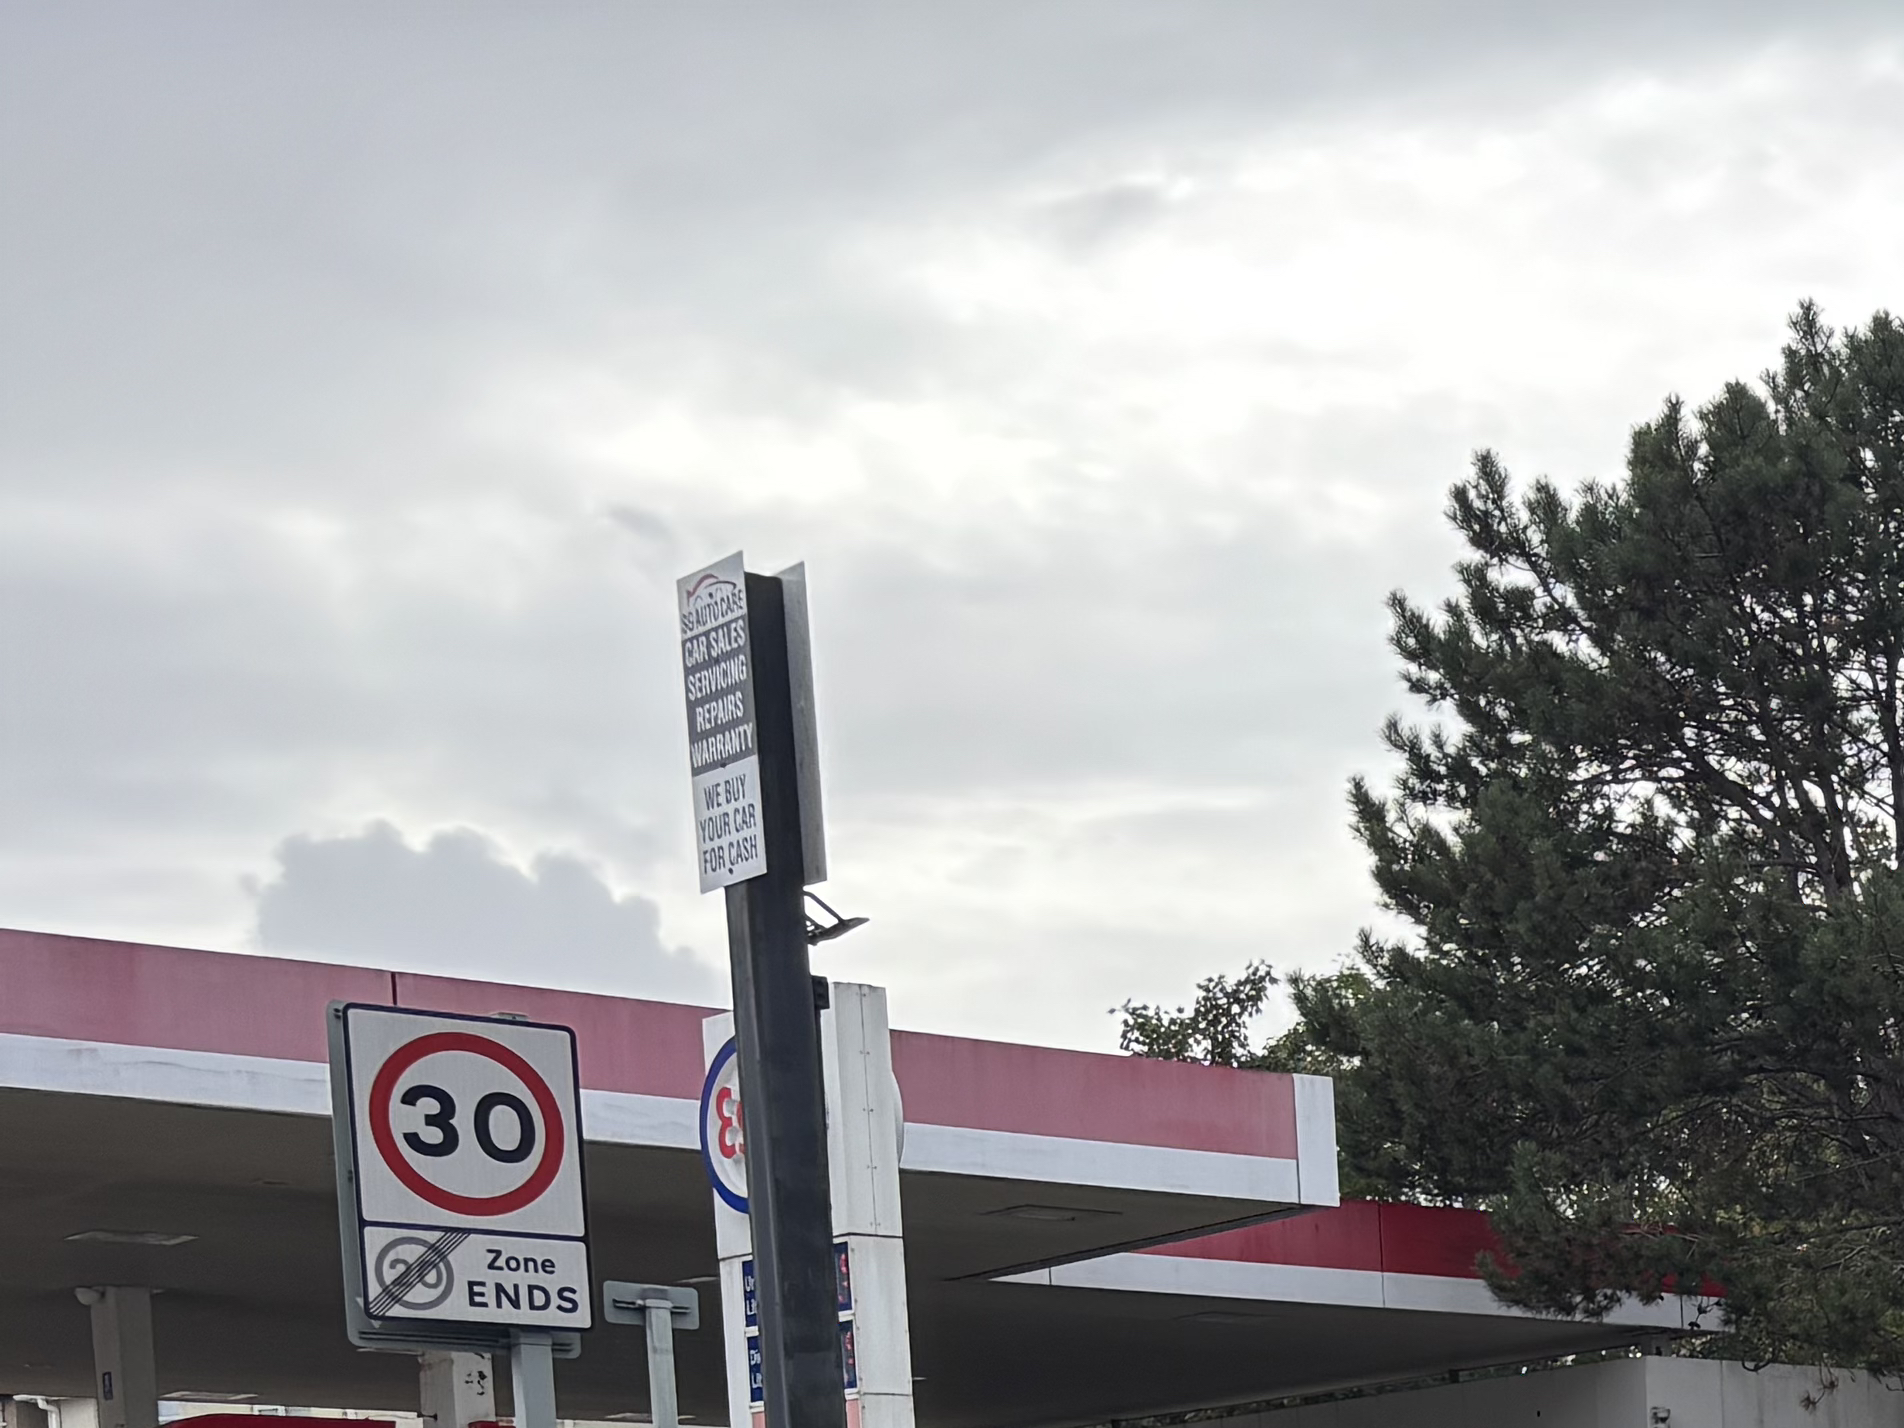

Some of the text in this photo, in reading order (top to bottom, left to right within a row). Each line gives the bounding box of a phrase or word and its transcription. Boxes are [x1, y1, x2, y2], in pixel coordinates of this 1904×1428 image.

[695, 599, 720, 630] AUTO
[720, 588, 744, 618] CARE
[685, 619, 746, 667] CAR SALES
[687, 654, 747, 701] SERVICING
[695, 696, 744, 733] REPAIRS
[691, 722, 753, 768] WARRANTY
[703, 773, 746, 811] WE BUY
[700, 803, 757, 844] YOUR CAR
[702, 834, 758, 875] FOR CASH
[400, 1084, 536, 1164] 30
[486, 1248, 556, 1275] Zone
[466, 1280, 579, 1314] ENDS
